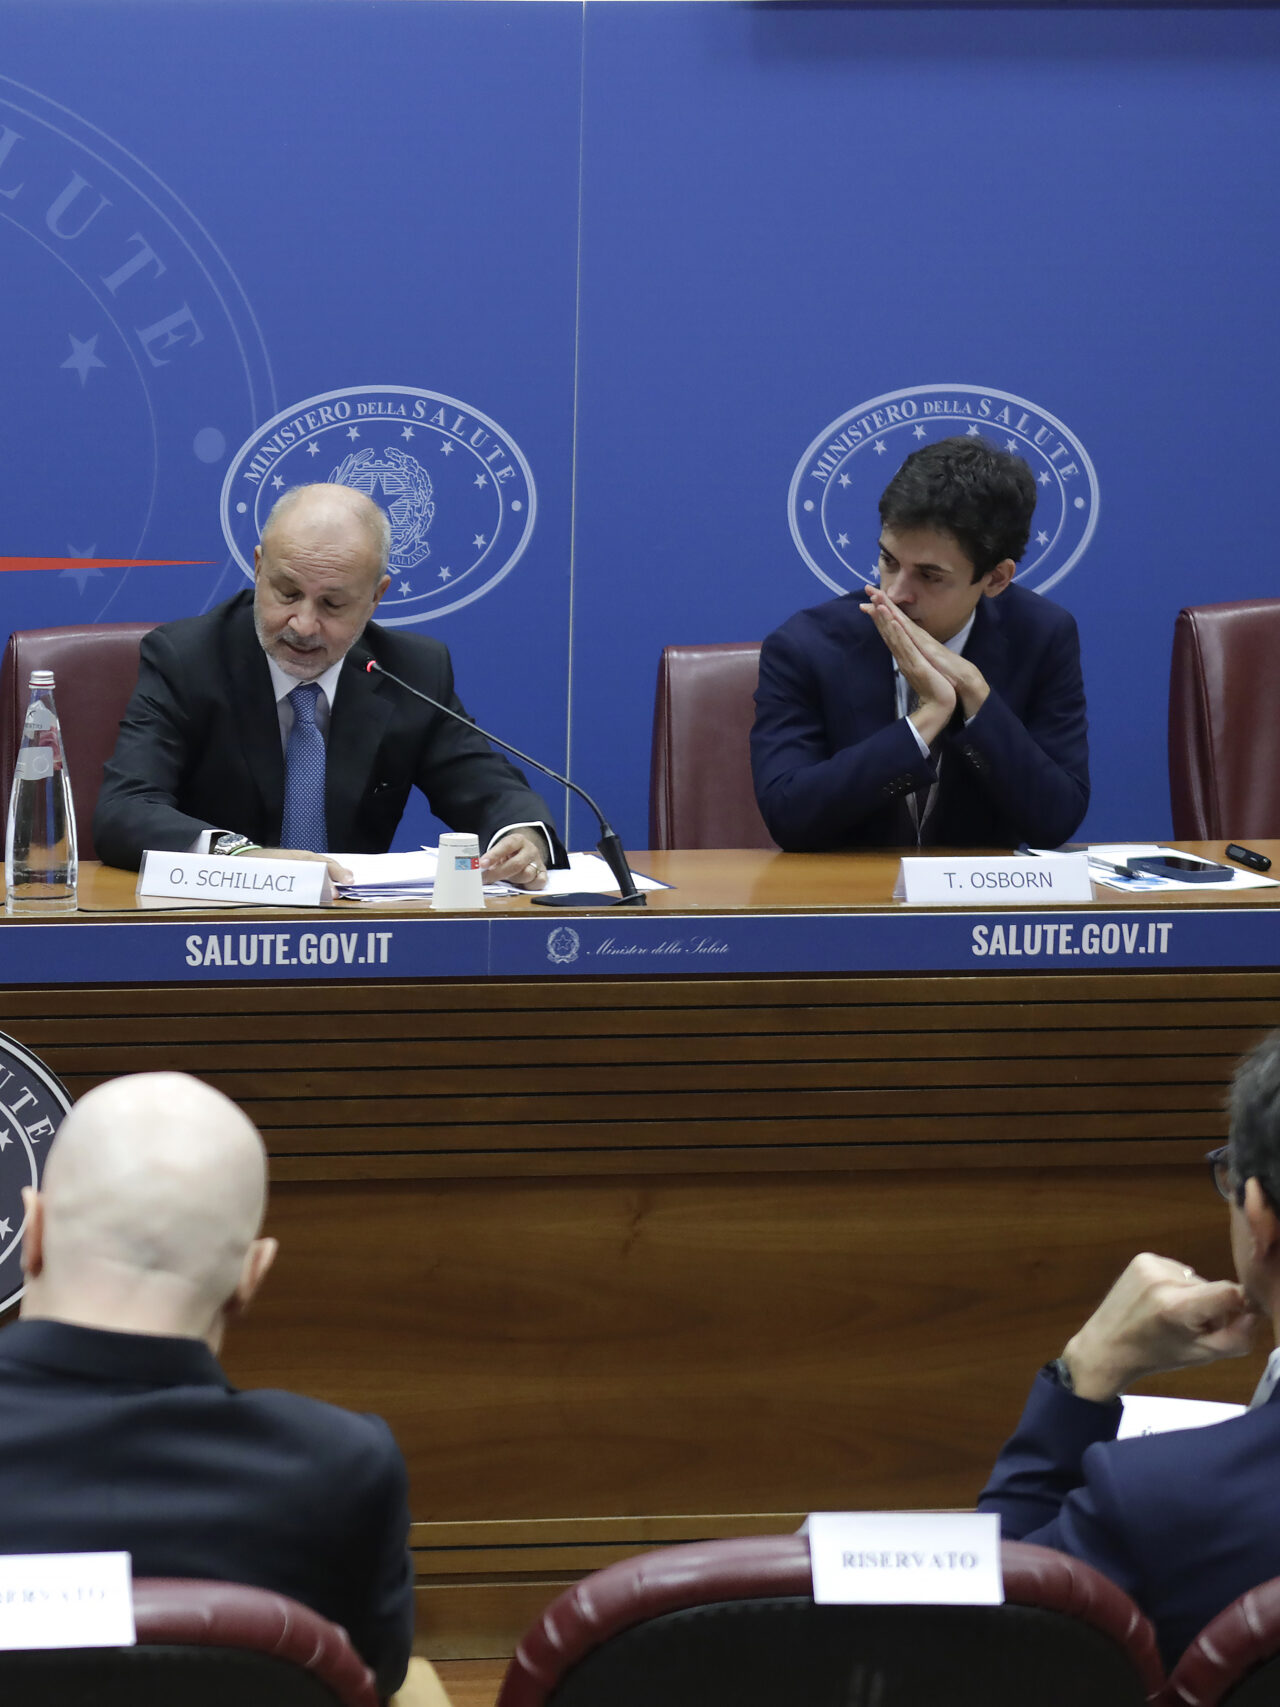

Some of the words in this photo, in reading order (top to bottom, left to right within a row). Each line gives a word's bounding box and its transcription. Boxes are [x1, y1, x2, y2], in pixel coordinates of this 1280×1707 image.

[243, 401, 351, 485] MINISTERO
[357, 402, 407, 416] DELLA
[412, 400, 517, 484] SALUTE
[810, 399, 918, 483] MINISTERO
[923, 400, 972, 415] DELLA
[977, 398, 1080, 481] SALUTE
[170, 867, 188, 885] O.
[196, 869, 297, 893] SCHILLACI
[943, 872, 963, 889] T.
[970, 872, 1053, 889] OSBORN
[185, 932, 393, 967] SALUTE.GOV.IT
[586, 937, 648, 956] Ministero
[650, 940, 682, 955] della
[684, 936, 730, 955] Salute
[971, 923, 1173, 956] SALUTE.GOV.IT
[841, 1551, 979, 1570] RISERVATO
